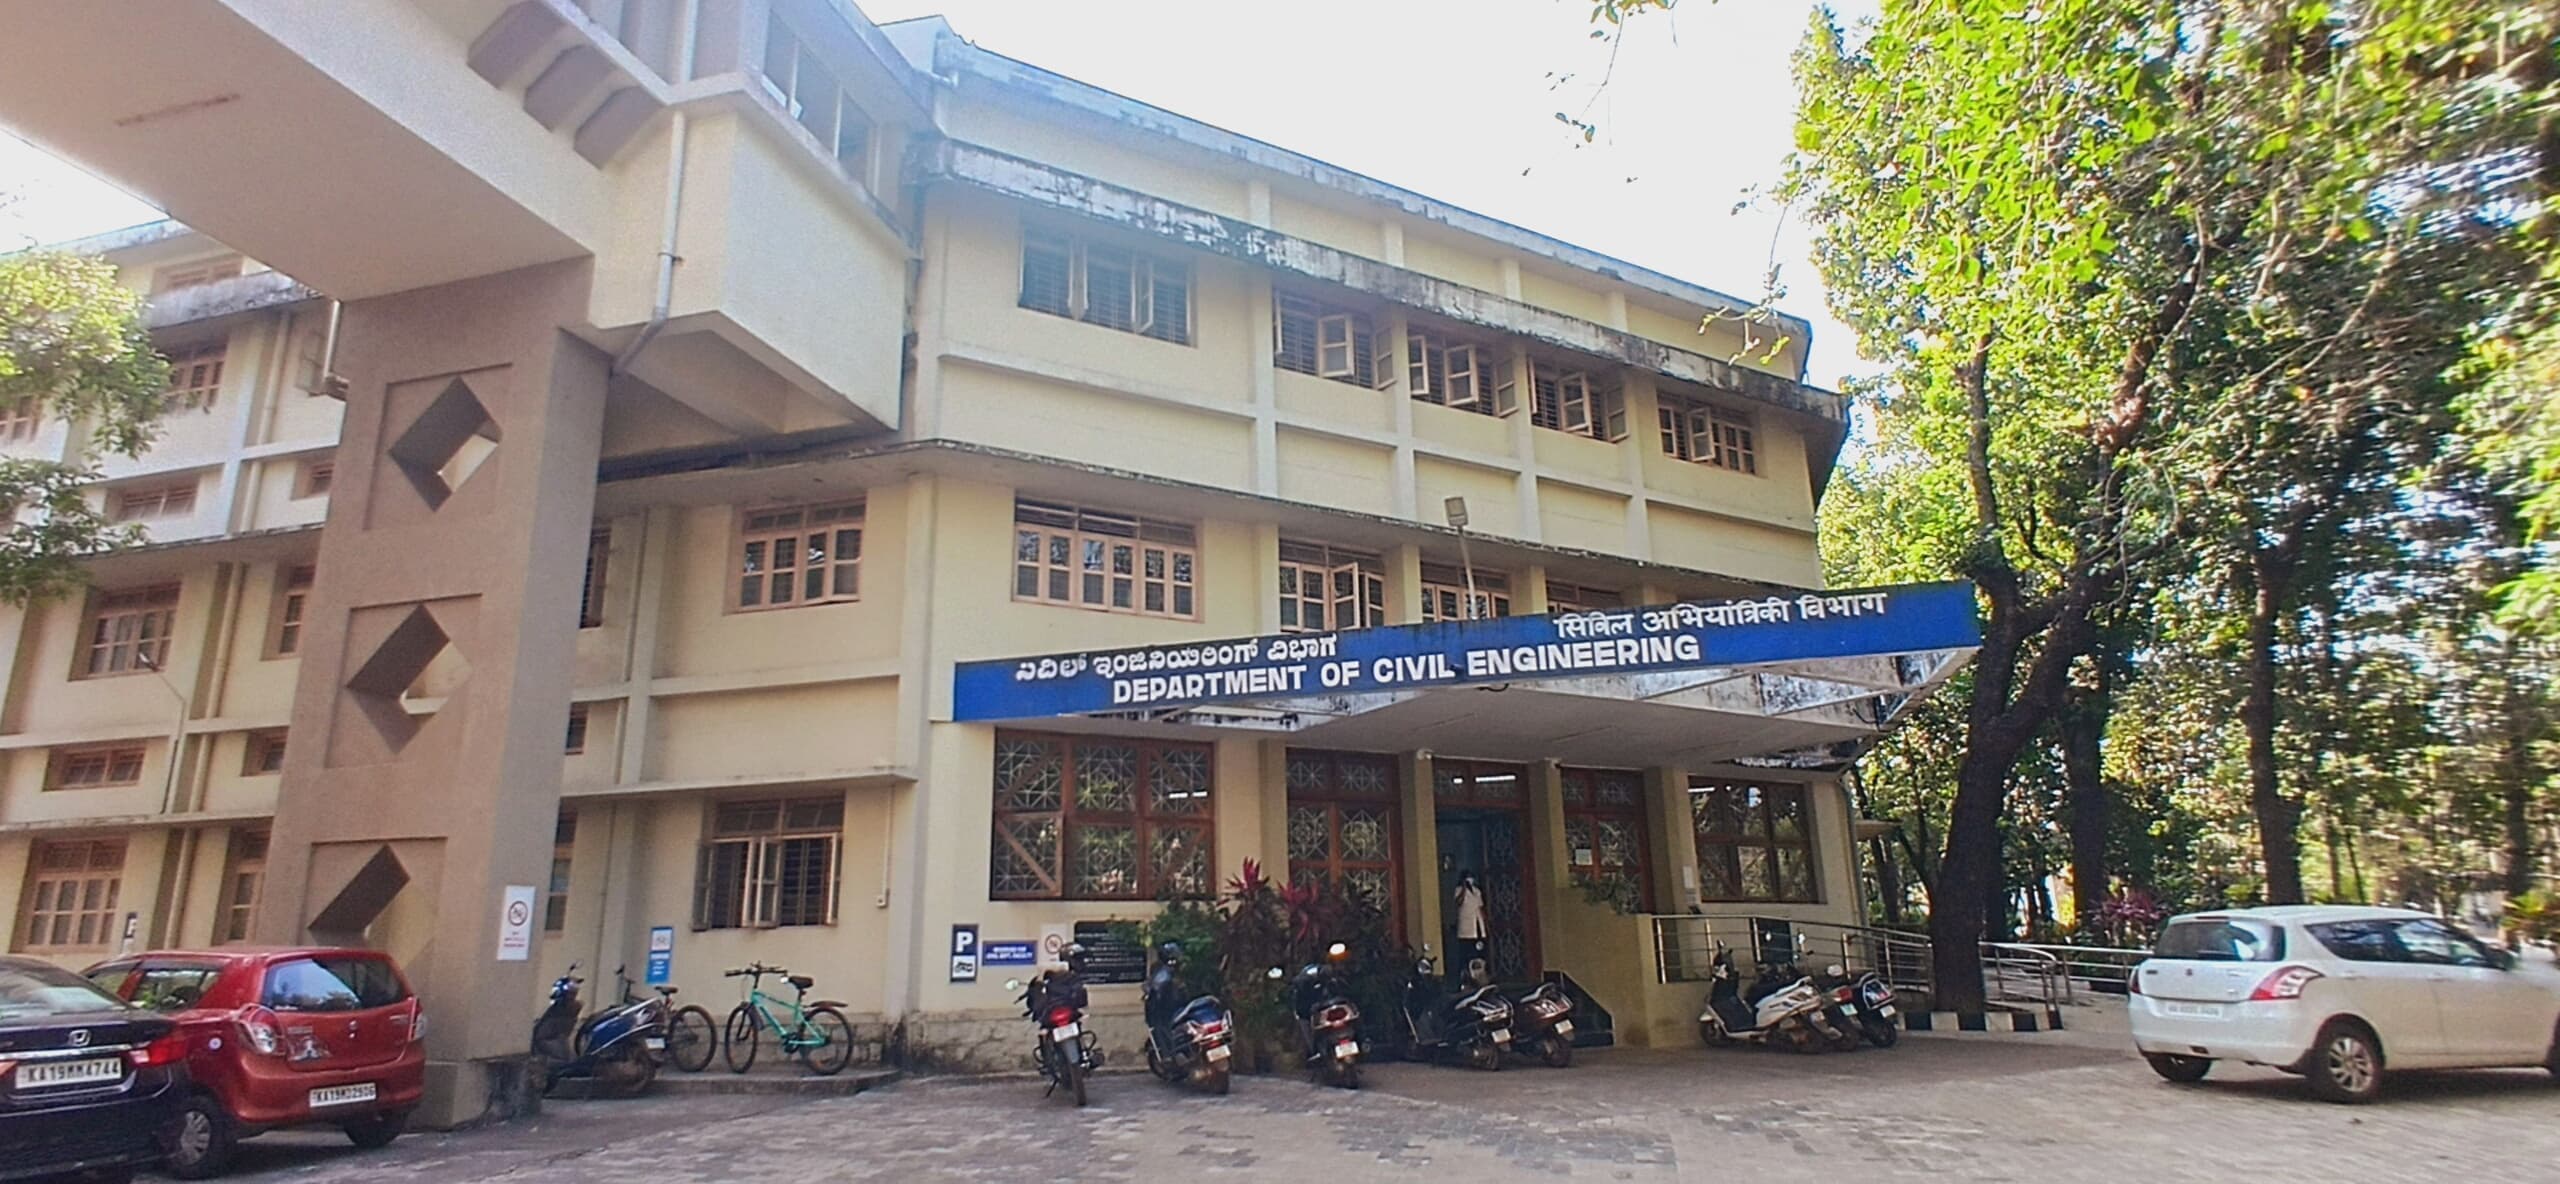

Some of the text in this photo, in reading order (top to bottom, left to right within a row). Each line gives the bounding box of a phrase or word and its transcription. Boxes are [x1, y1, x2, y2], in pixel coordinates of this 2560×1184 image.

[1552, 592, 1888, 639] सिविल अभियांत्रिकी विभाग
[1267, 633, 1337, 662] ವಿಭಾಗ
[1114, 634, 1700, 704] DEPARTMENT OF CIVIL ENGINEERING
[956, 931, 974, 954] P
